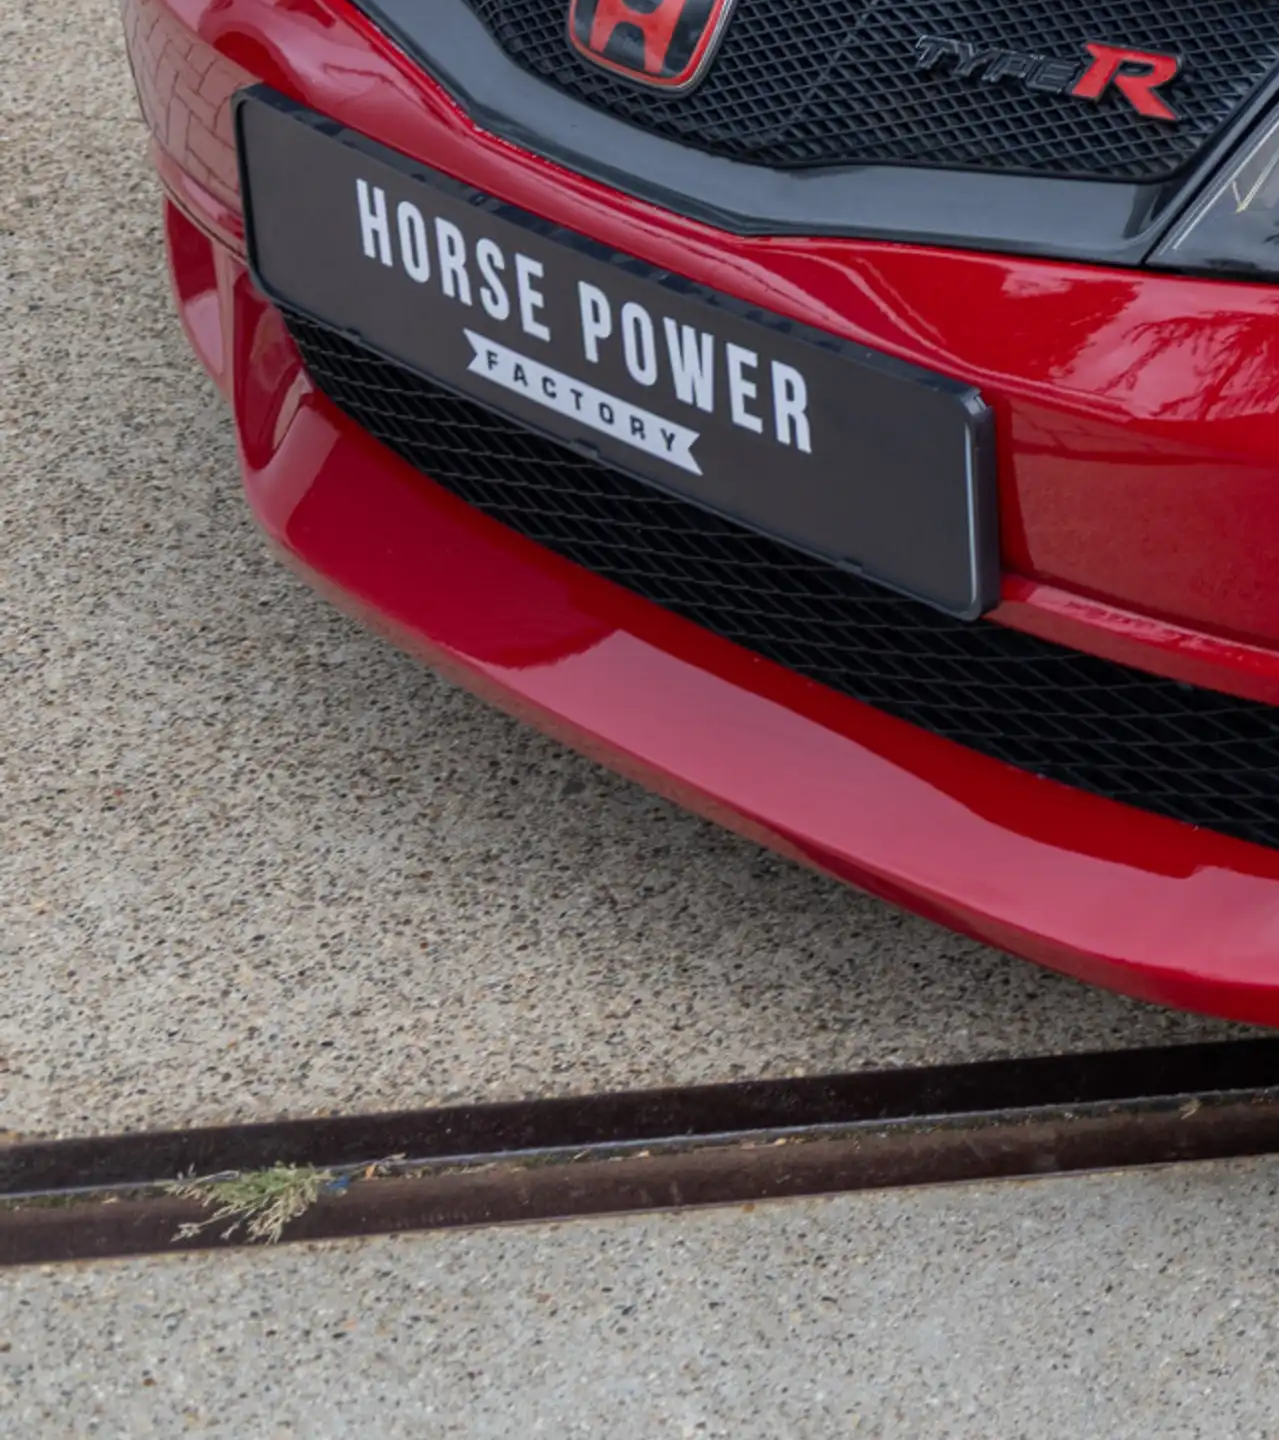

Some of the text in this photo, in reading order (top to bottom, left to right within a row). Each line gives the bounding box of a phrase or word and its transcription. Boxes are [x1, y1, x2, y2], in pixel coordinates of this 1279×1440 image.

[913, 33, 1184, 122] TYPE R
[355, 178, 813, 455] HORSE POWER
[486, 349, 679, 453] FACTORY
